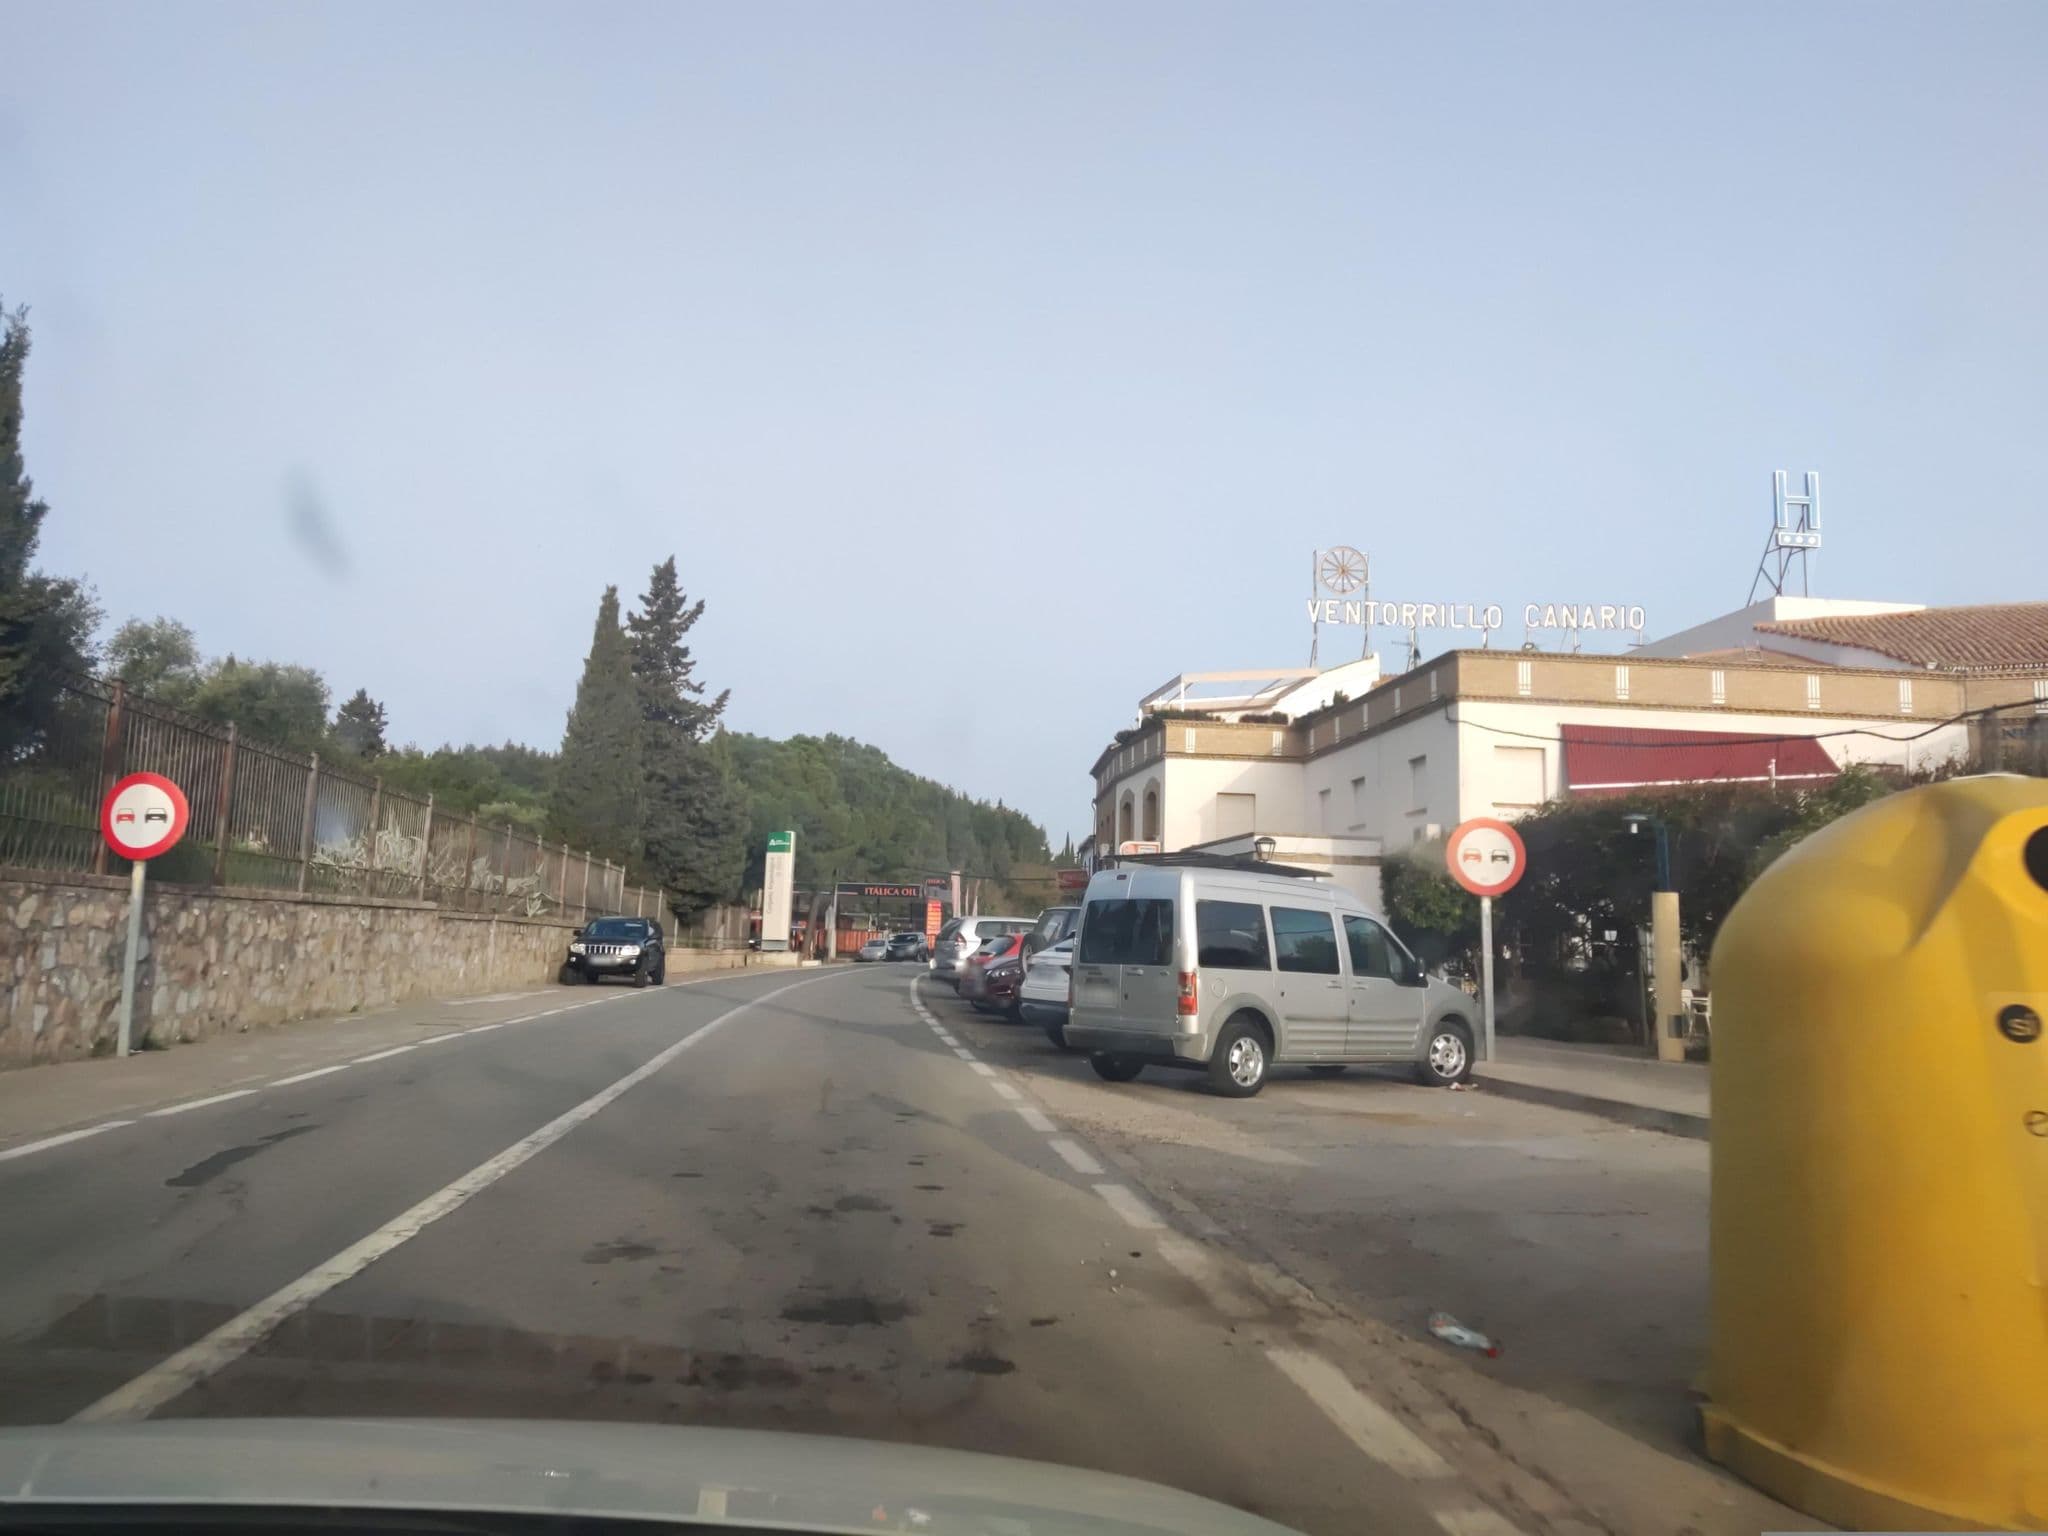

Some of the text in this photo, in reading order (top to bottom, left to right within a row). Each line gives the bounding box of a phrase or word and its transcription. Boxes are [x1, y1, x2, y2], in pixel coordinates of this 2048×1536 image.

[1774, 469, 1821, 530] H
[1307, 600, 1646, 630] VENTORRILLO CANARIO
[901, 887, 919, 897] OIL
